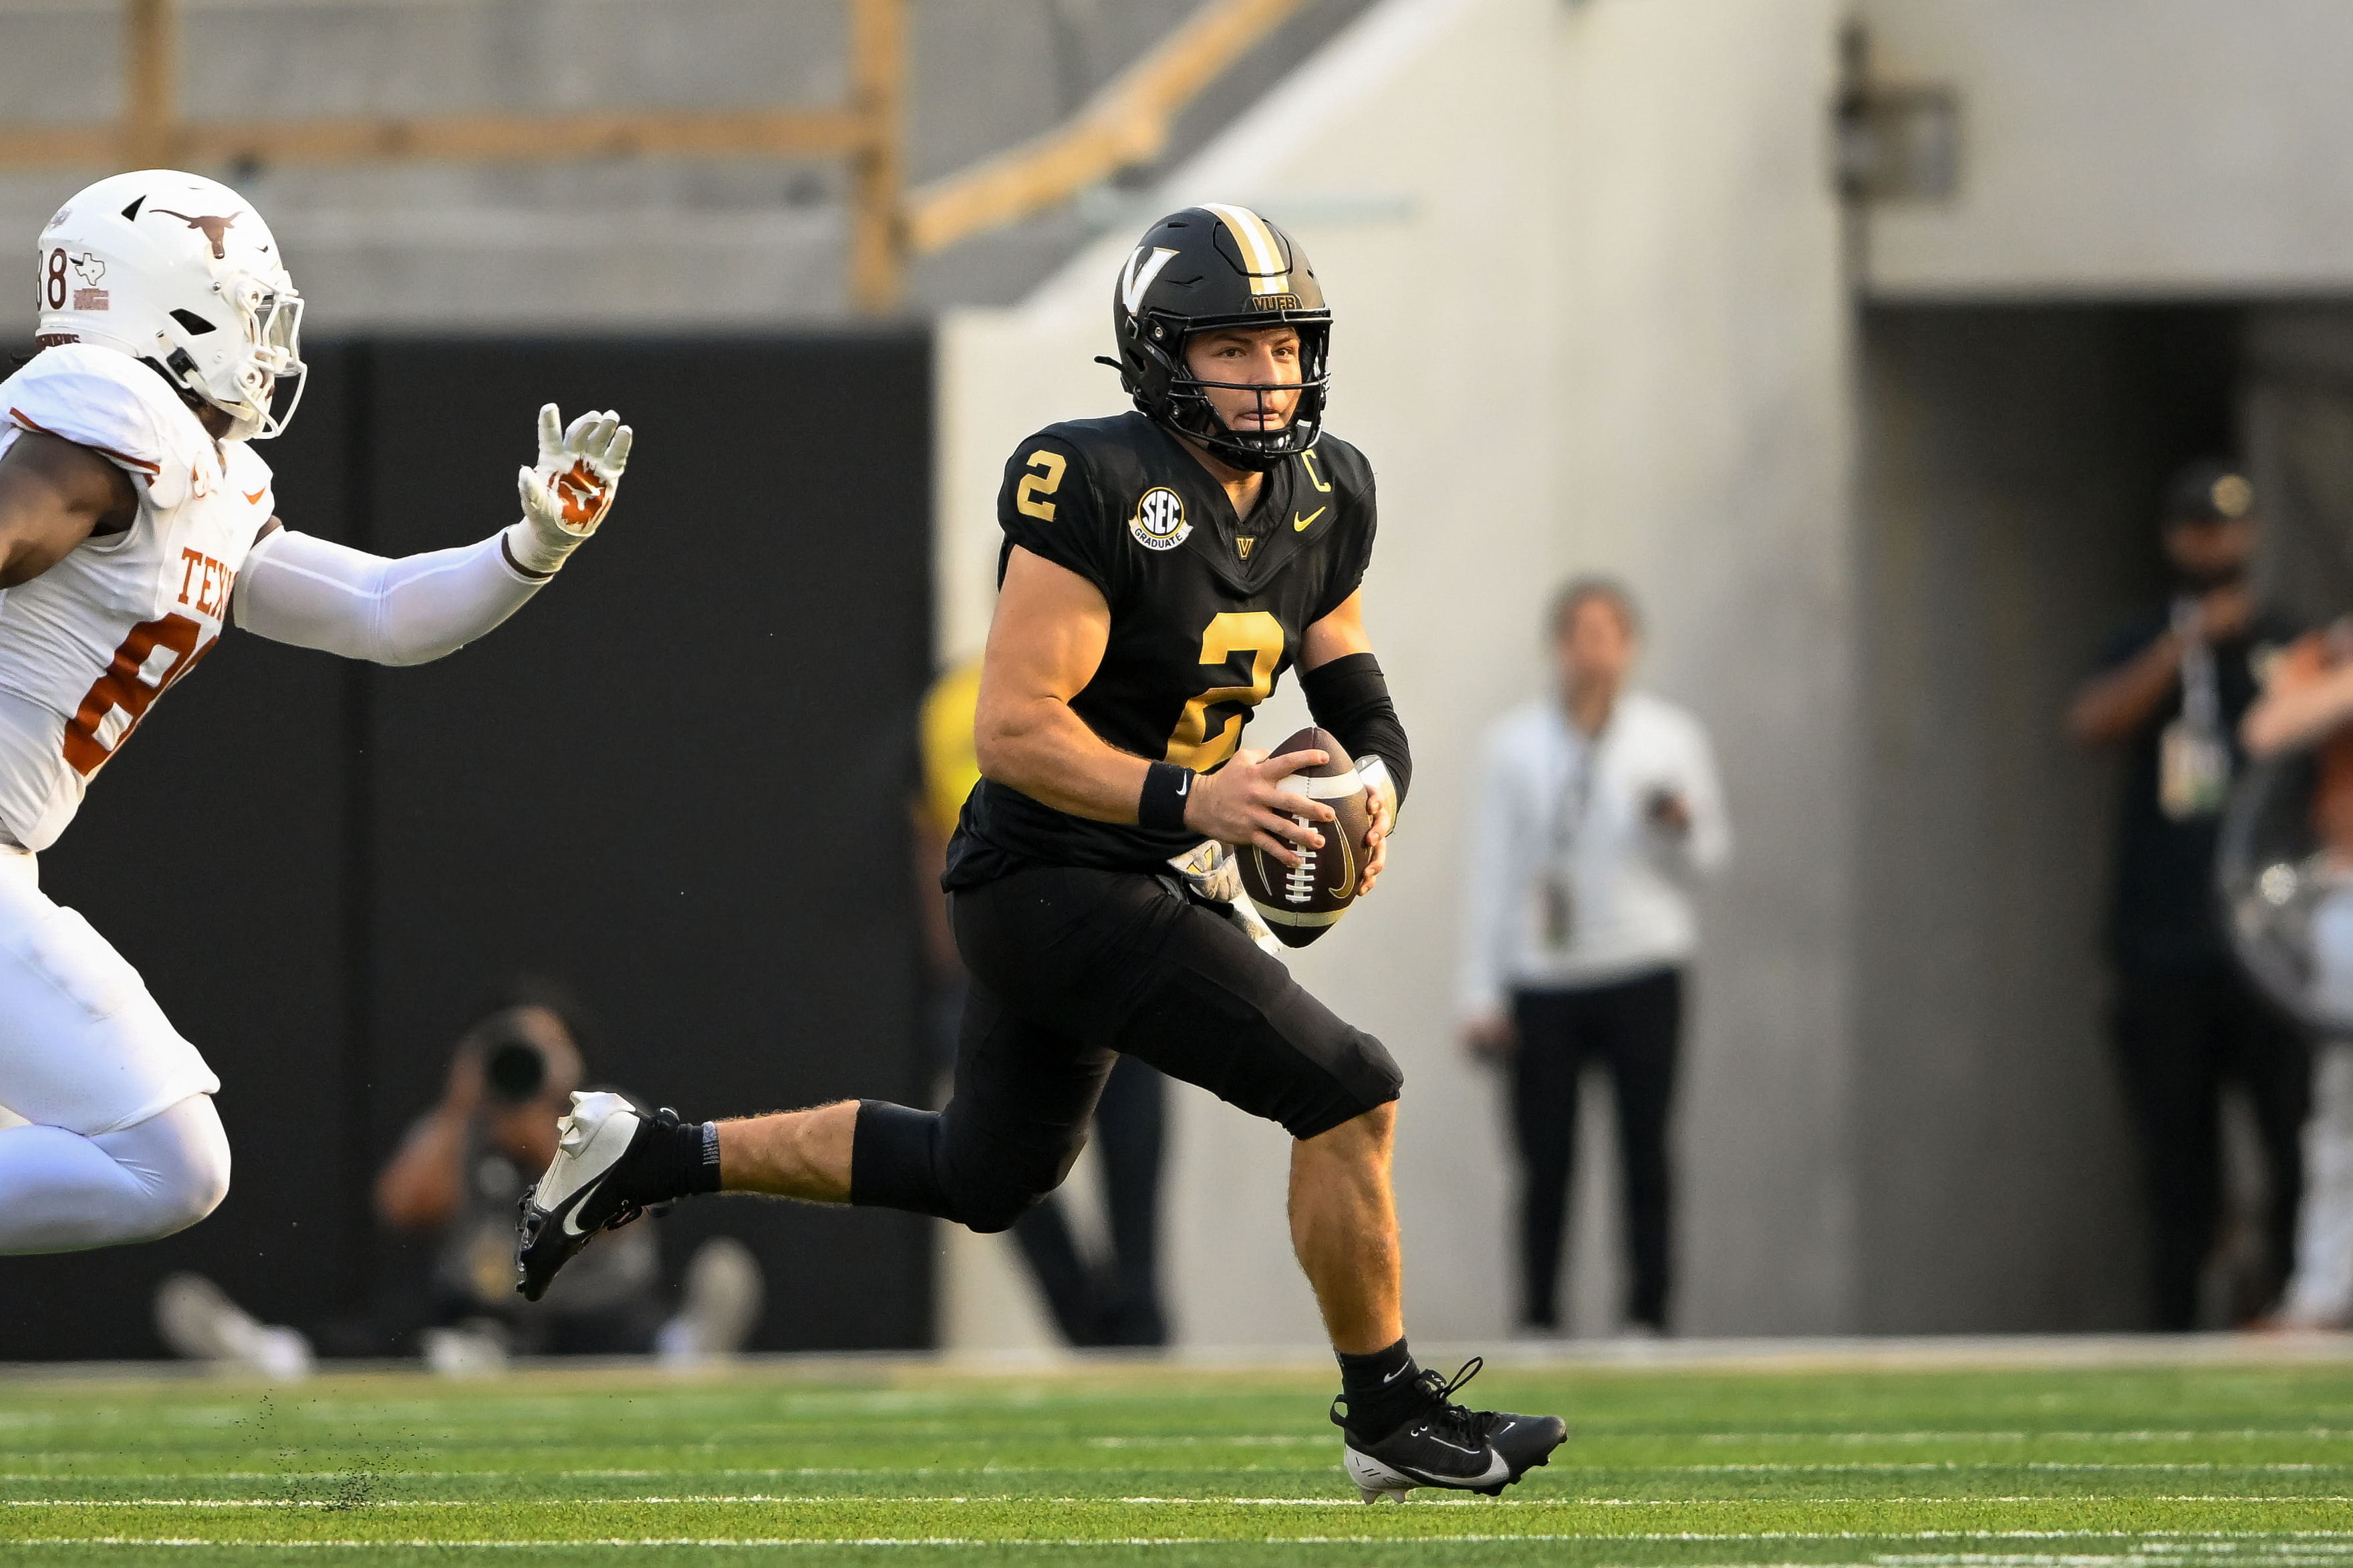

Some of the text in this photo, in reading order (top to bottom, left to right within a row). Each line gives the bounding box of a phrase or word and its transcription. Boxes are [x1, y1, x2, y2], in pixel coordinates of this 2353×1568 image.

[37, 248, 67, 311] 8
[1122, 246, 1180, 317] V
[1252, 295, 1296, 311] VUFB
[1017, 449, 1067, 522] 2
[1300, 448, 1332, 492] C
[1134, 528, 1183, 548] GRADUATE
[1141, 490, 1180, 534] SEC
[1236, 536, 1255, 559] V
[178, 546, 239, 621] TEX
[63, 611, 219, 778] 8
[1163, 611, 1284, 774] 2
